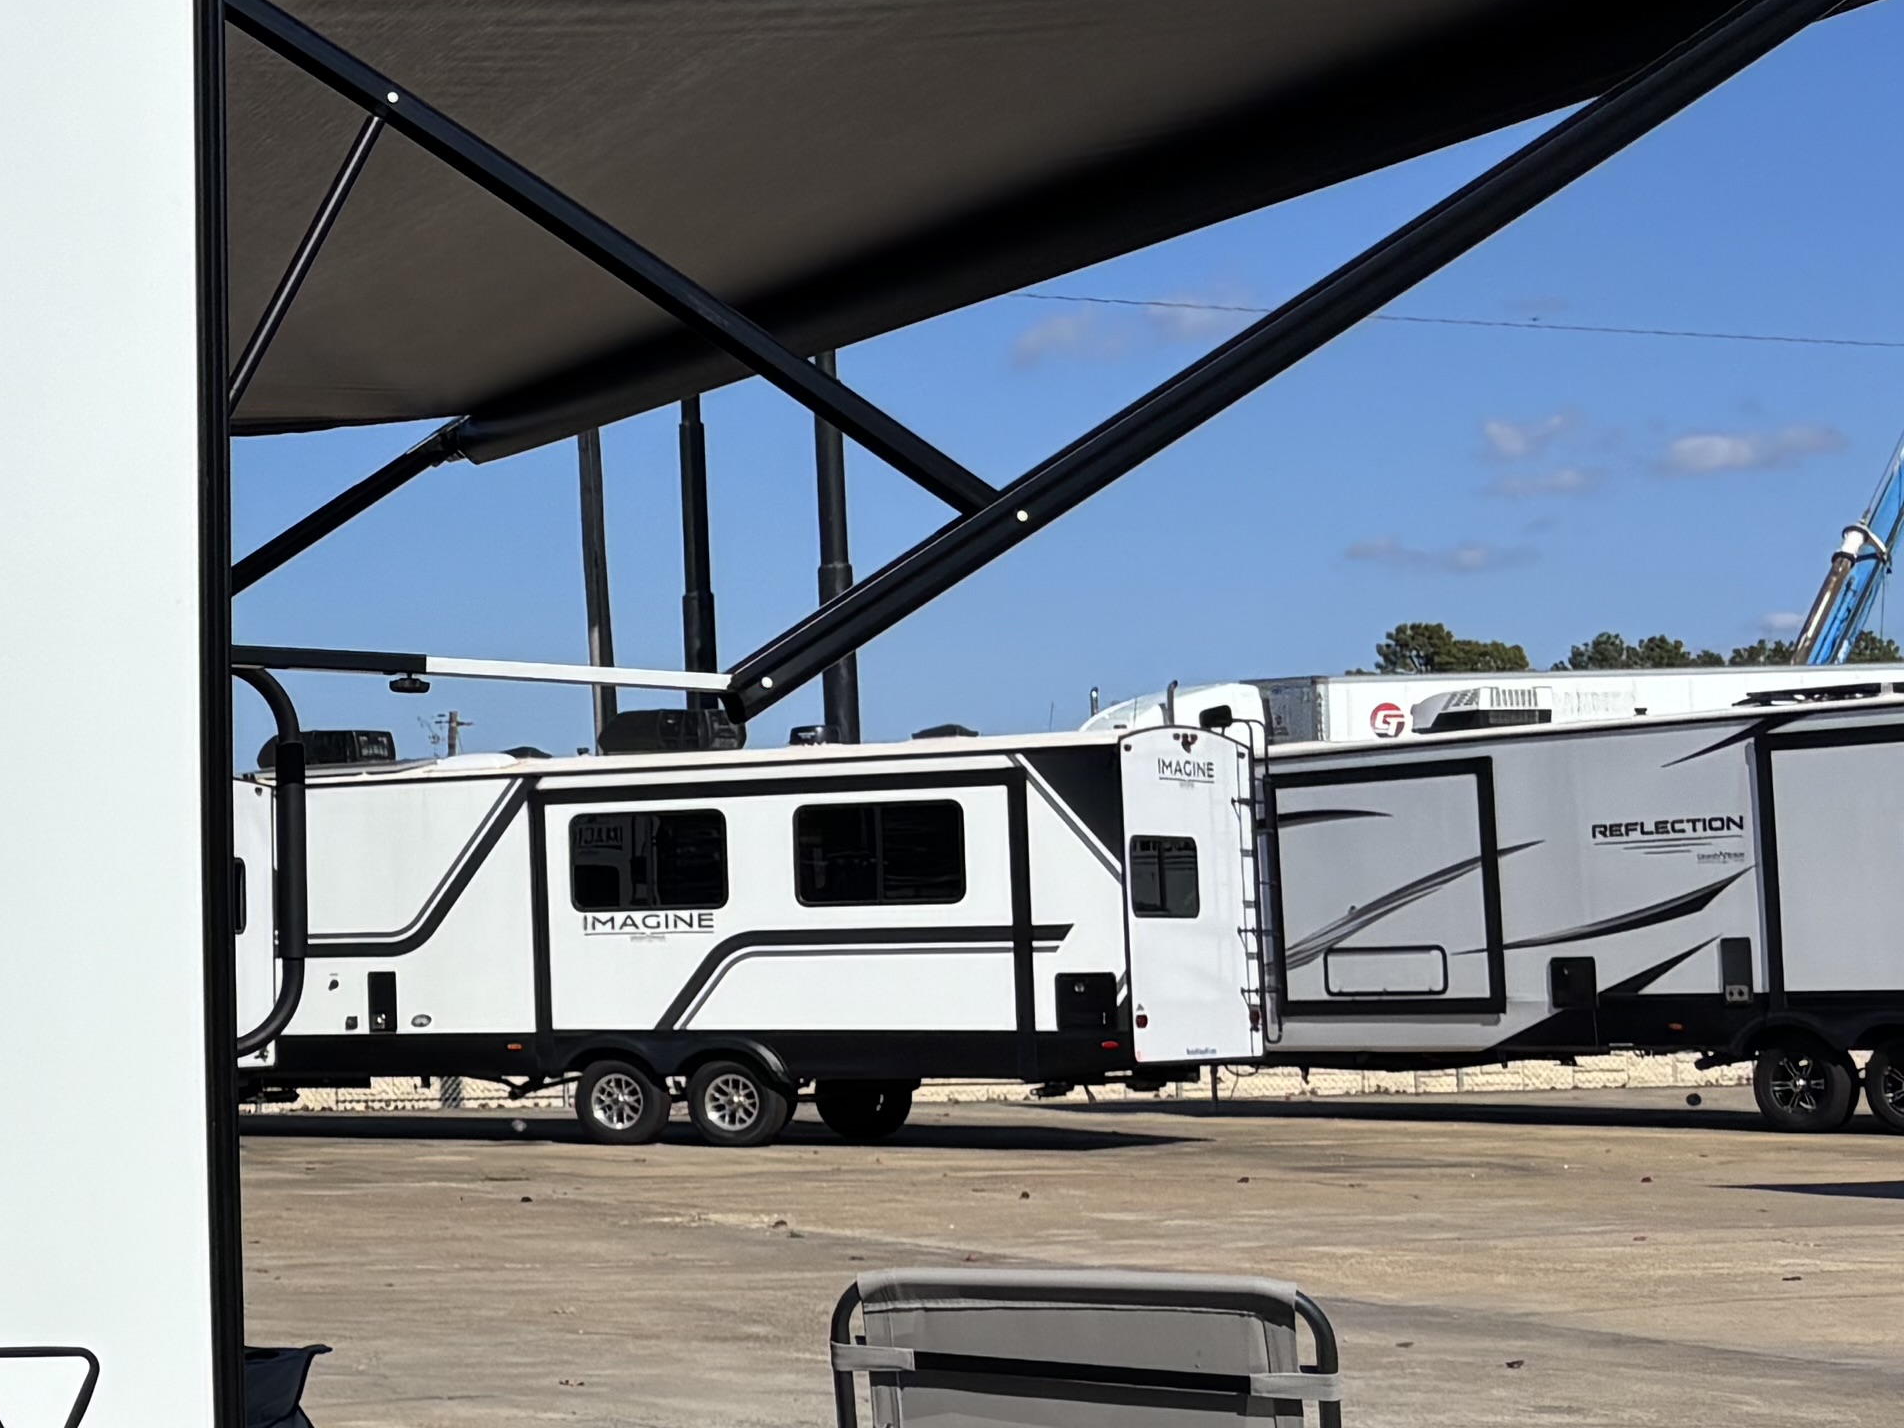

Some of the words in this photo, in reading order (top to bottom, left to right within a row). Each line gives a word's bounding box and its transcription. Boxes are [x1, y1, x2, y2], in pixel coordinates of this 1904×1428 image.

[1157, 758, 1215, 778] IMAGINE
[1591, 815, 1744, 839] REFLECTION
[583, 912, 714, 931] IMAGINE
